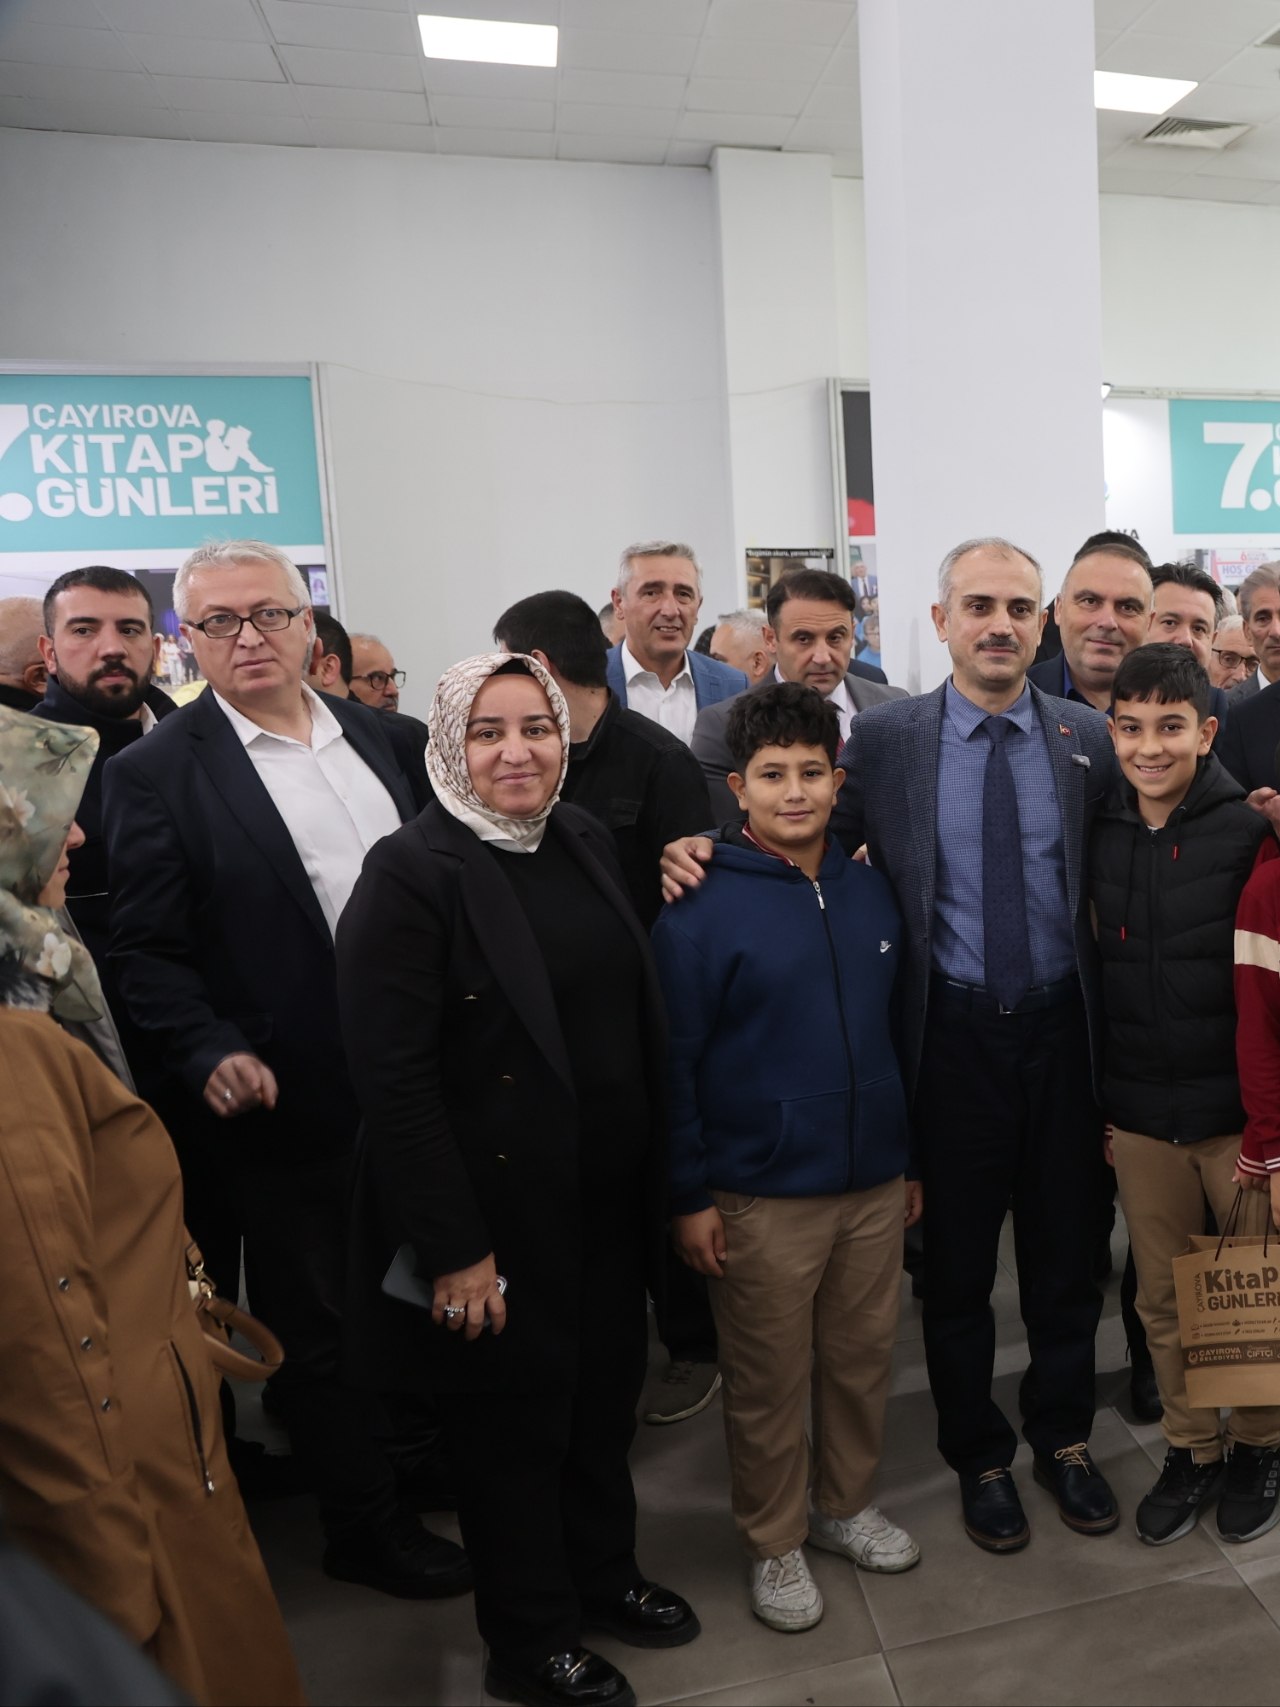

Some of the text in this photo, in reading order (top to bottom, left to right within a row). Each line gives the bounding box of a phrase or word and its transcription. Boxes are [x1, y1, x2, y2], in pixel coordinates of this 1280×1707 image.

[33, 404, 201, 428] ÇAYIROVA
[31, 433, 204, 473] KİTAP
[1203, 421, 1273, 512] 7.
[36, 475, 280, 518] GÜNLERİ
